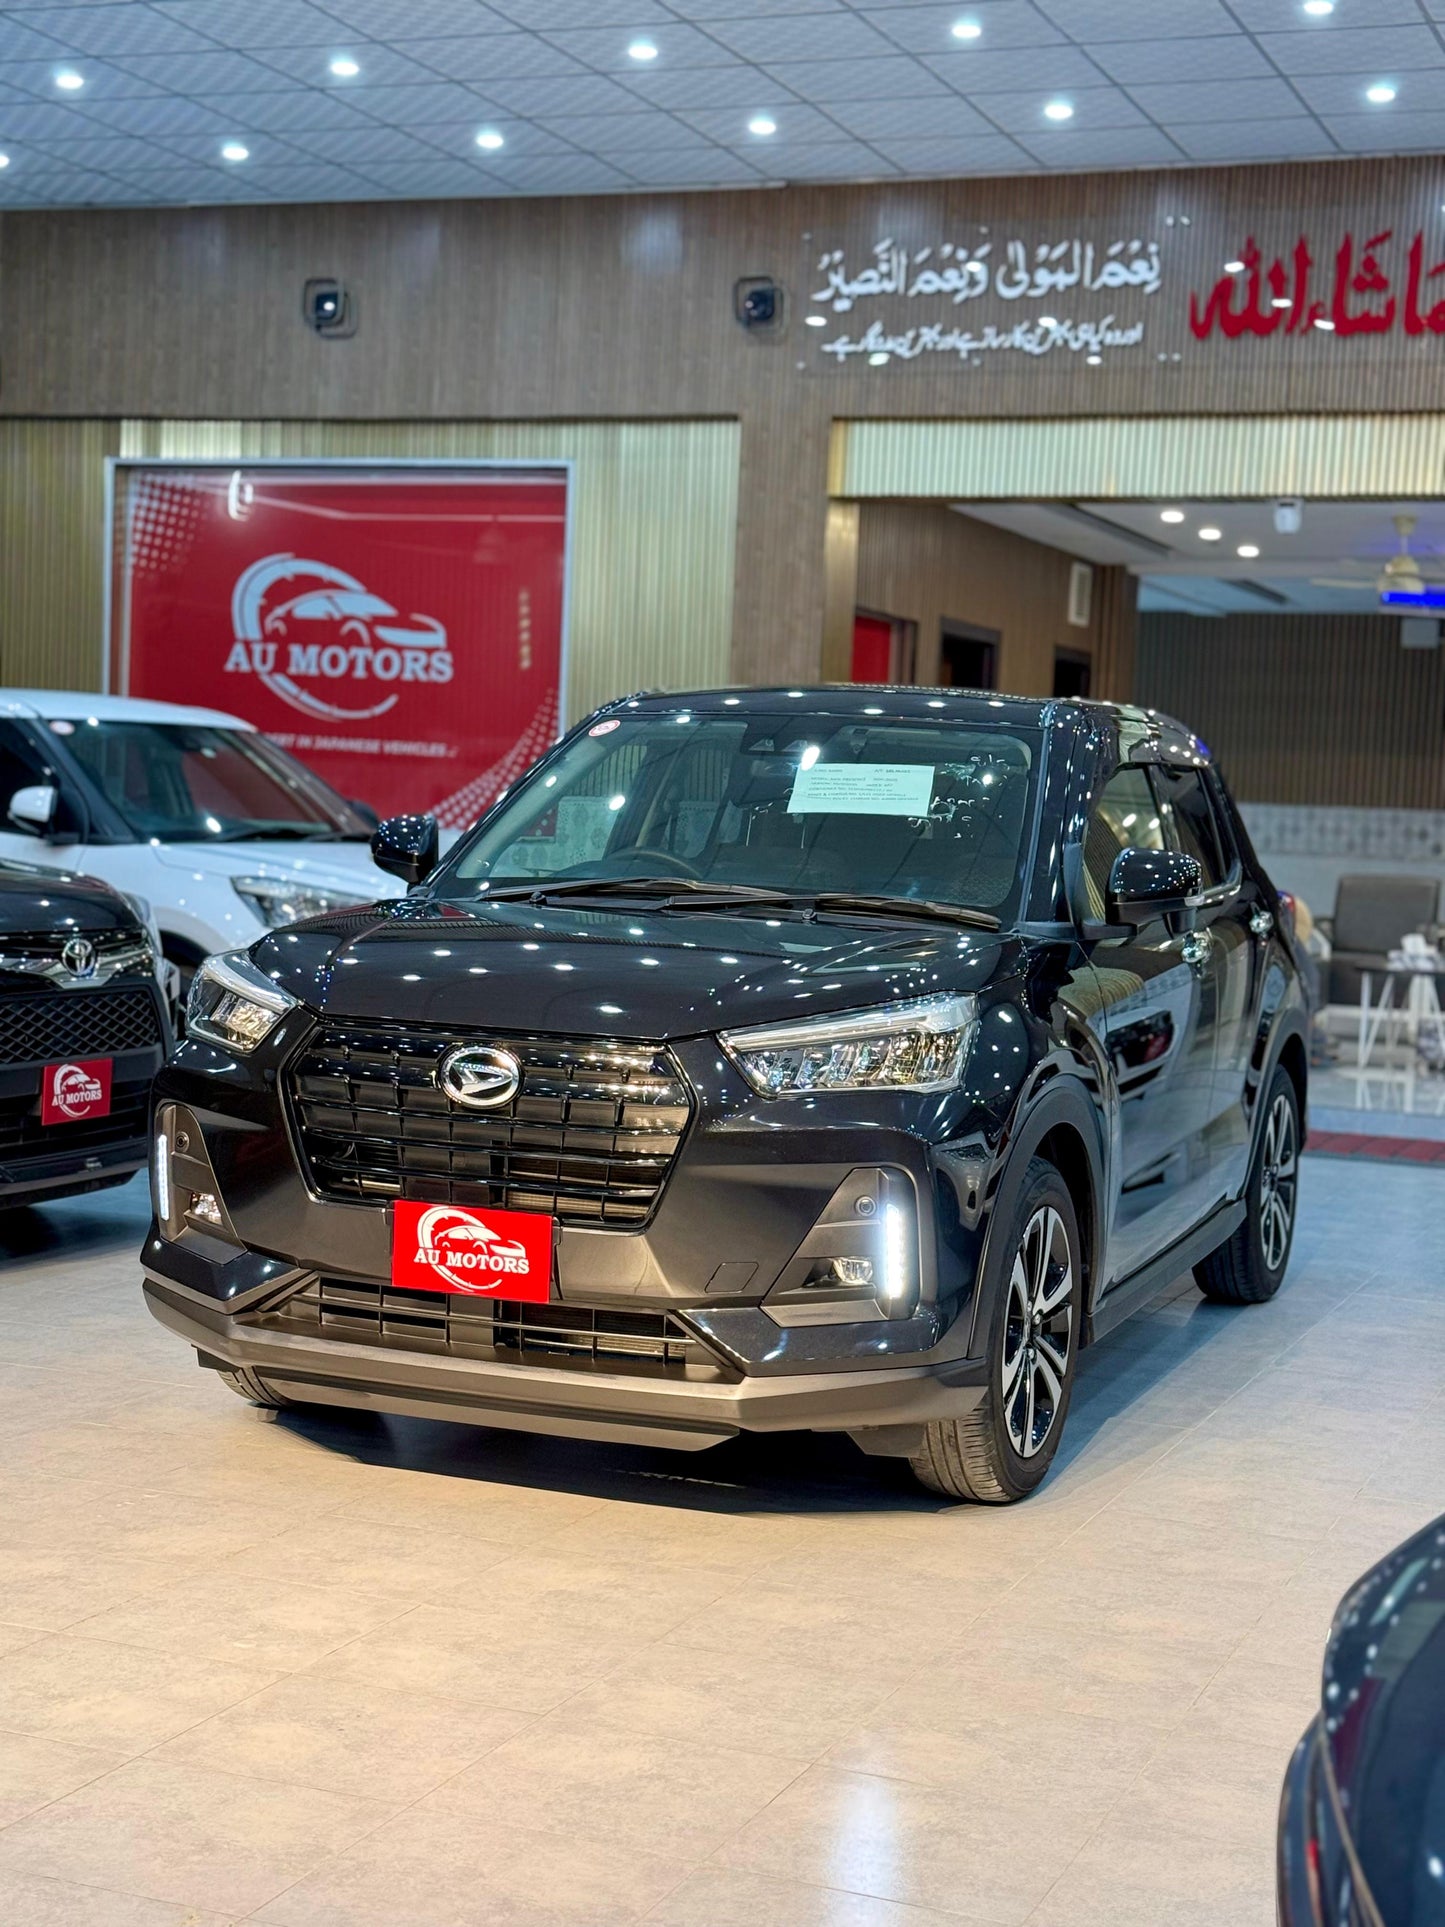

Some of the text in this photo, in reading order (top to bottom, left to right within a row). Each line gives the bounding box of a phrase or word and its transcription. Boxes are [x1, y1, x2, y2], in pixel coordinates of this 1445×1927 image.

[224, 641, 453, 683] AU MOTORS
[51, 1089, 102, 1106] AU MOTORS
[413, 1248, 530, 1275] AU MOTORS
